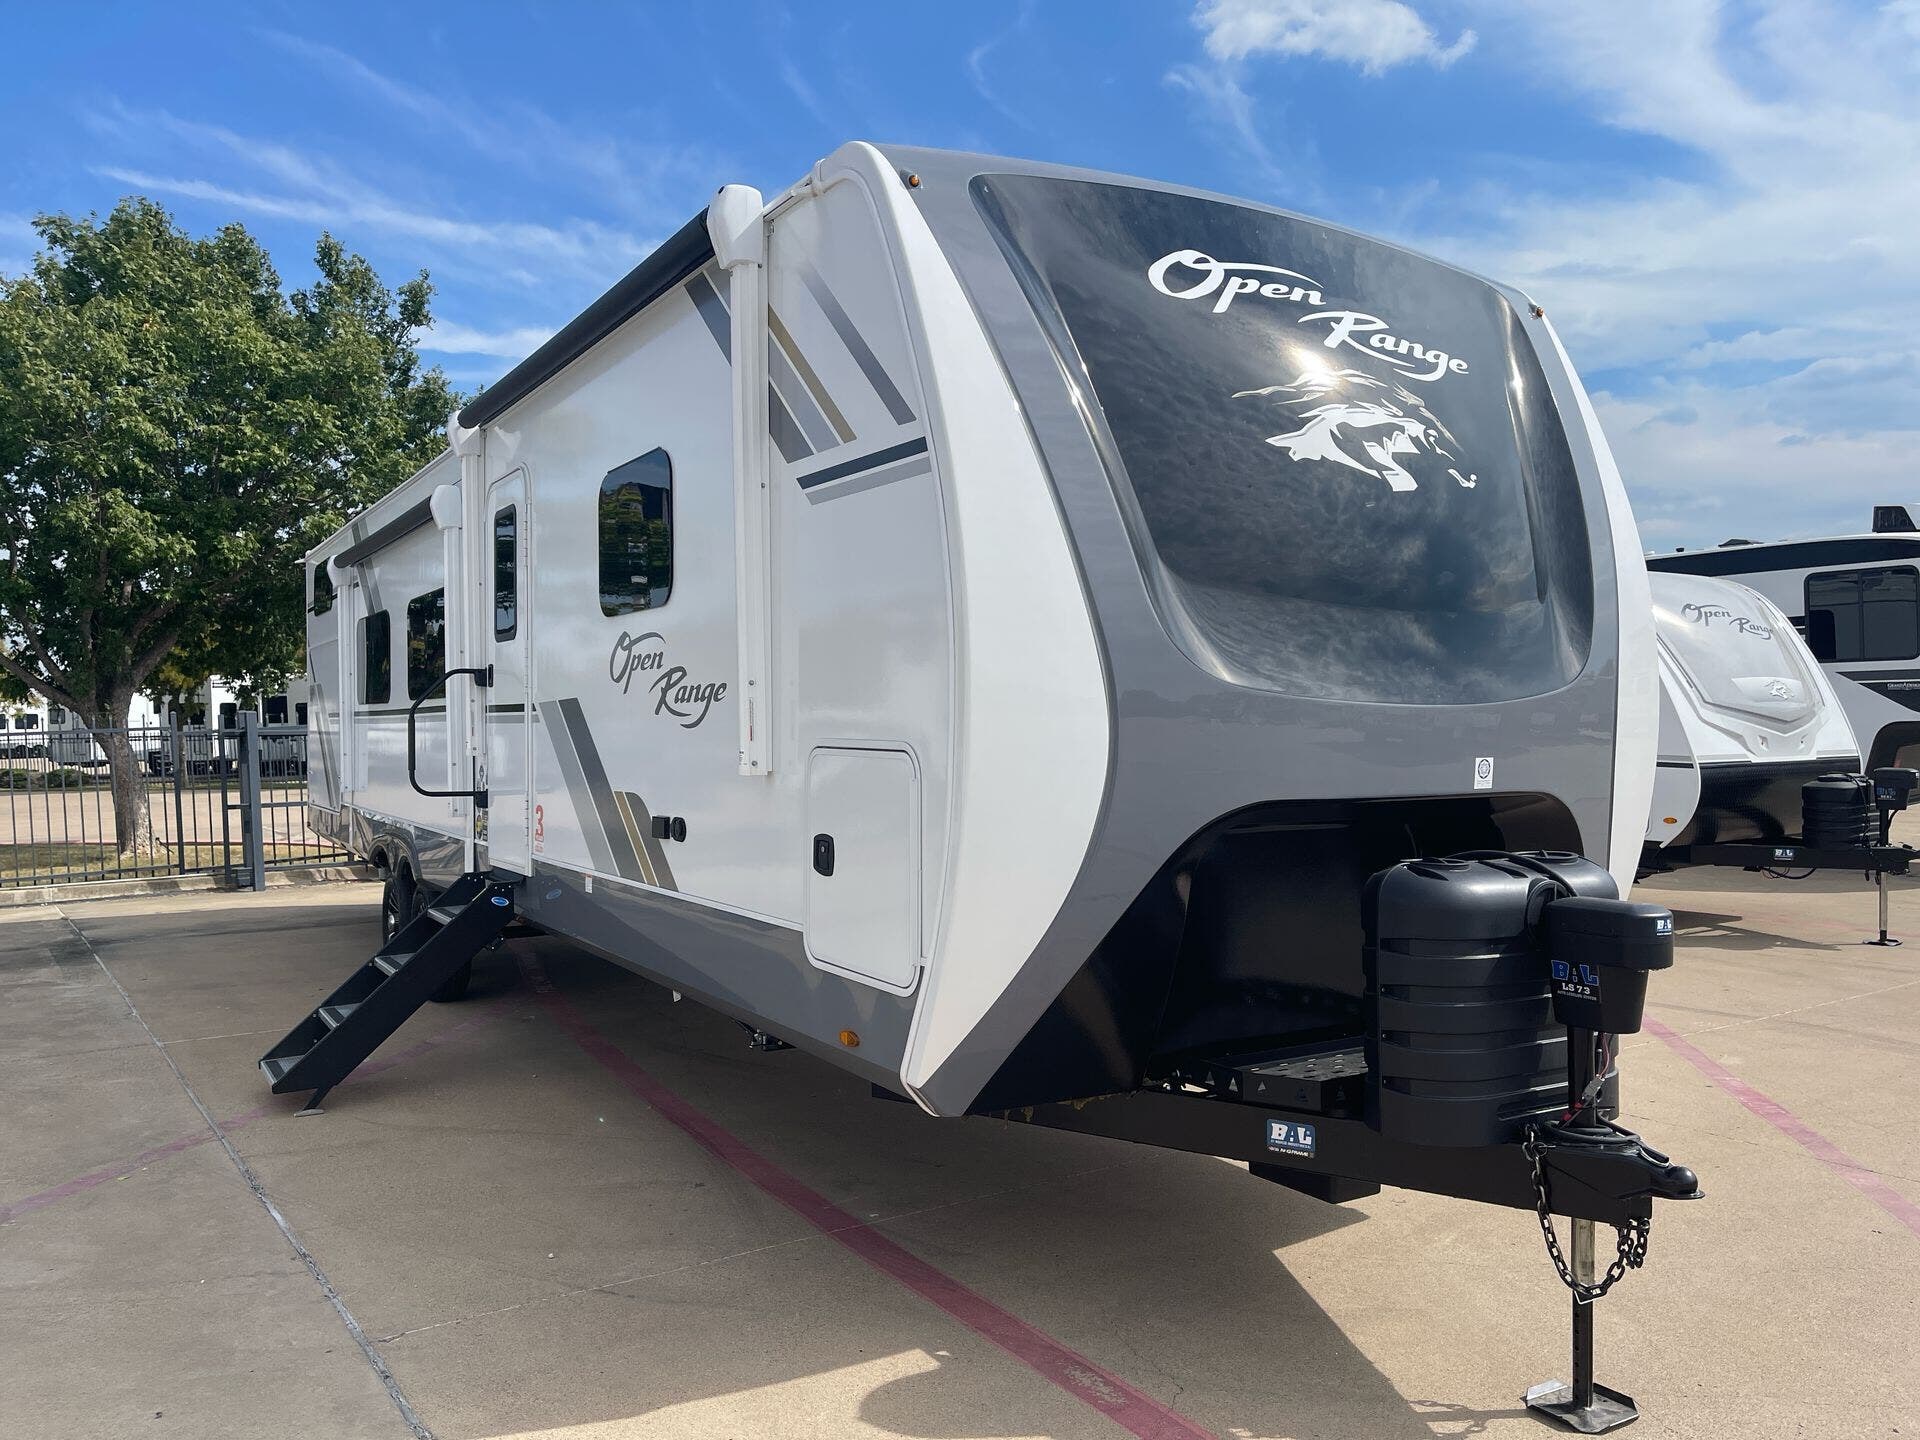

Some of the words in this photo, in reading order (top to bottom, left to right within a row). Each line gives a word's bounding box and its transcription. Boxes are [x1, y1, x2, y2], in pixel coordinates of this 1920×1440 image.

[1148, 249, 1326, 313] Open
[1298, 310, 1469, 382] Range
[1681, 603, 1731, 626] Open
[610, 630, 666, 694] Open
[648, 665, 727, 729] Range
[1551, 960, 1599, 986] BAL
[1562, 983, 1575, 991] LS
[1271, 1123, 1312, 1145] BAL
